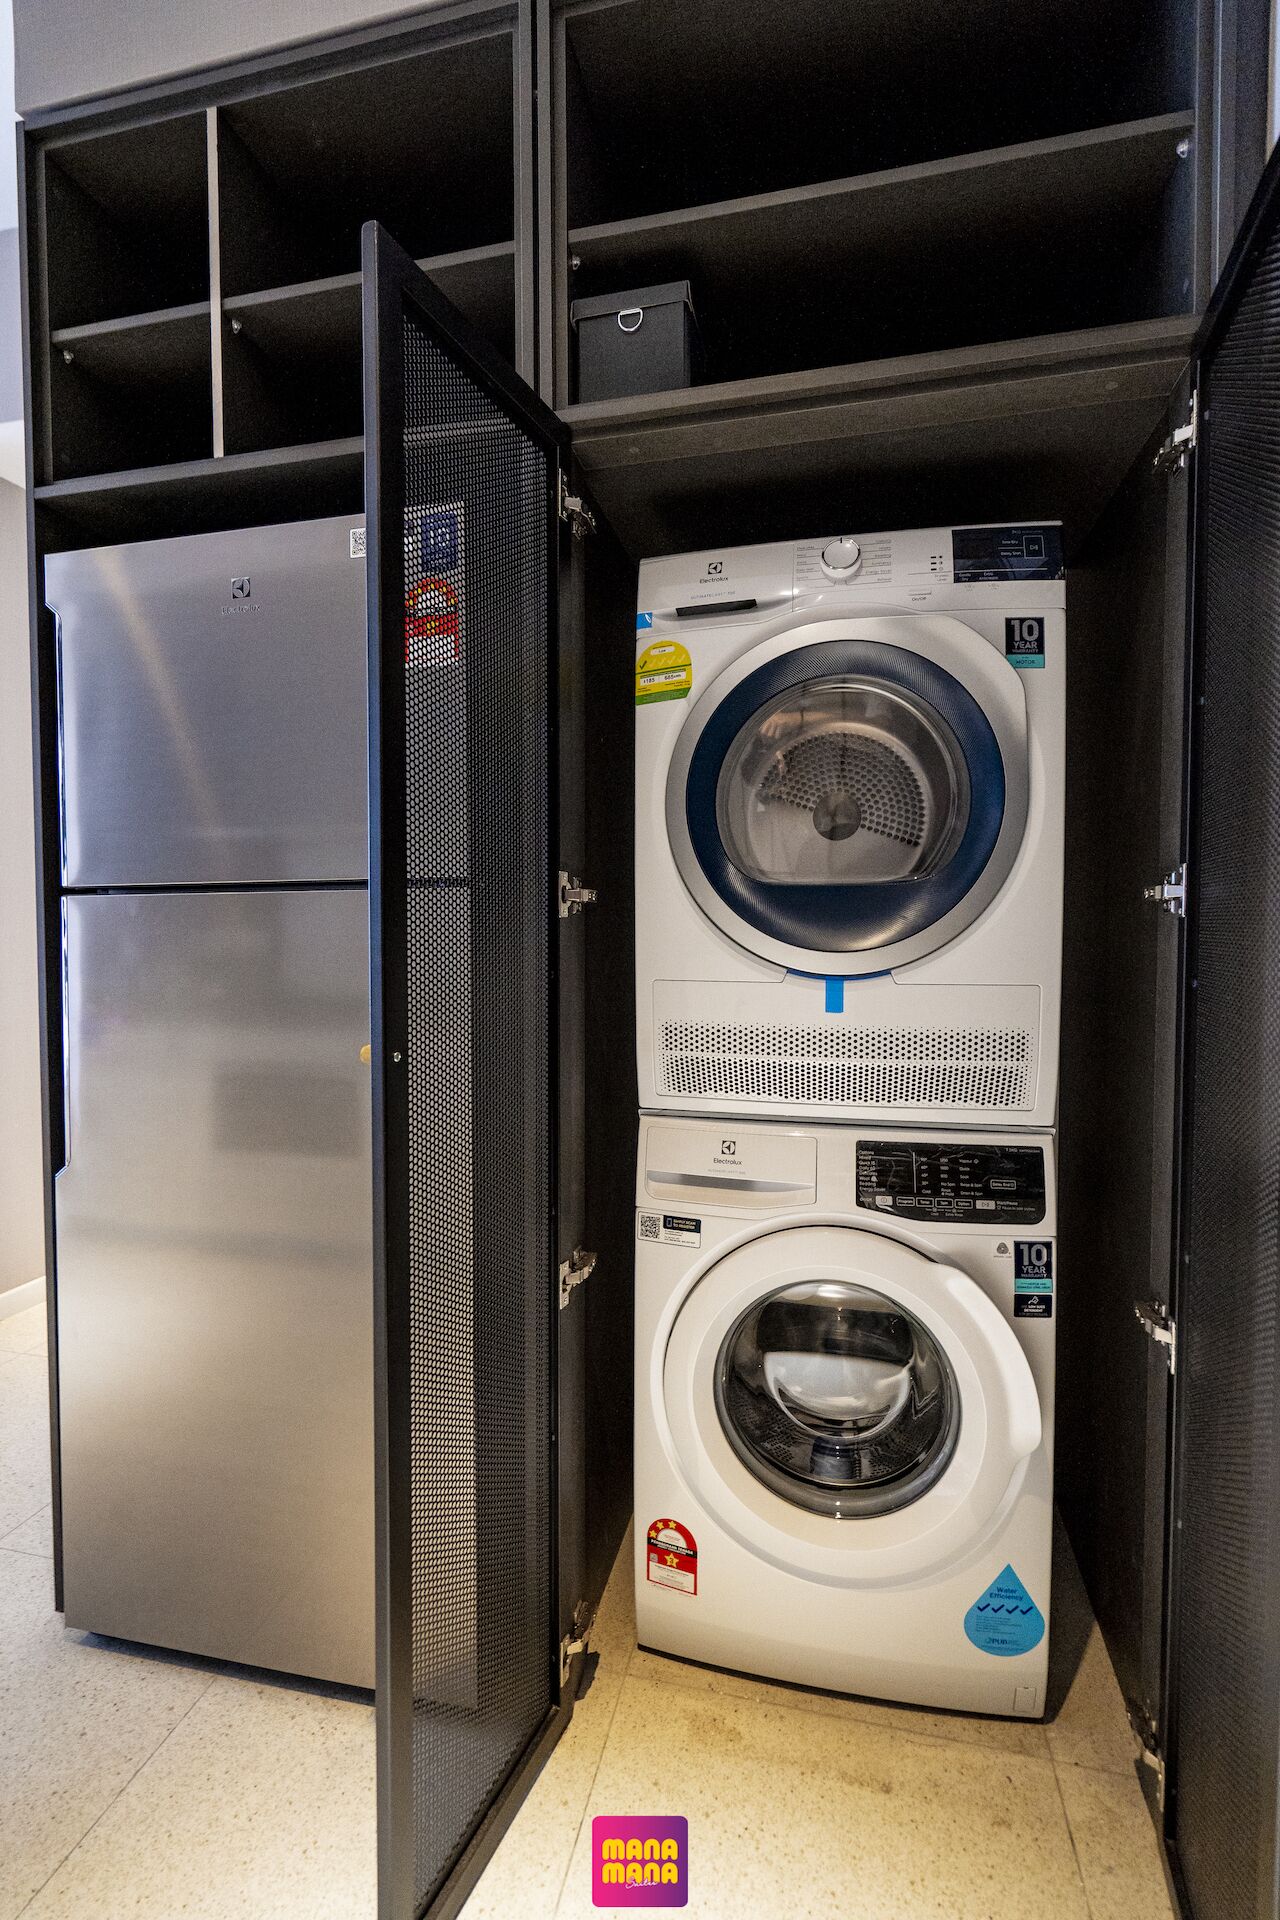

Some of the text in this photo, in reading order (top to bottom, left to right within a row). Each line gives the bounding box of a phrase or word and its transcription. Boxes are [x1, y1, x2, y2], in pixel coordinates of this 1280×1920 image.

[699, 576, 728, 585] Electrolux
[221, 603, 261, 616] Electrolux
[1011, 619, 1039, 641] 10
[1013, 641, 1038, 649] YEAR
[713, 1157, 743, 1166] Electrolux
[1020, 1244, 1047, 1266] 10
[1022, 1266, 1046, 1274] YEAR
[996, 1586, 1018, 1594] Water
[989, 1592, 1024, 1601] Efficiency
